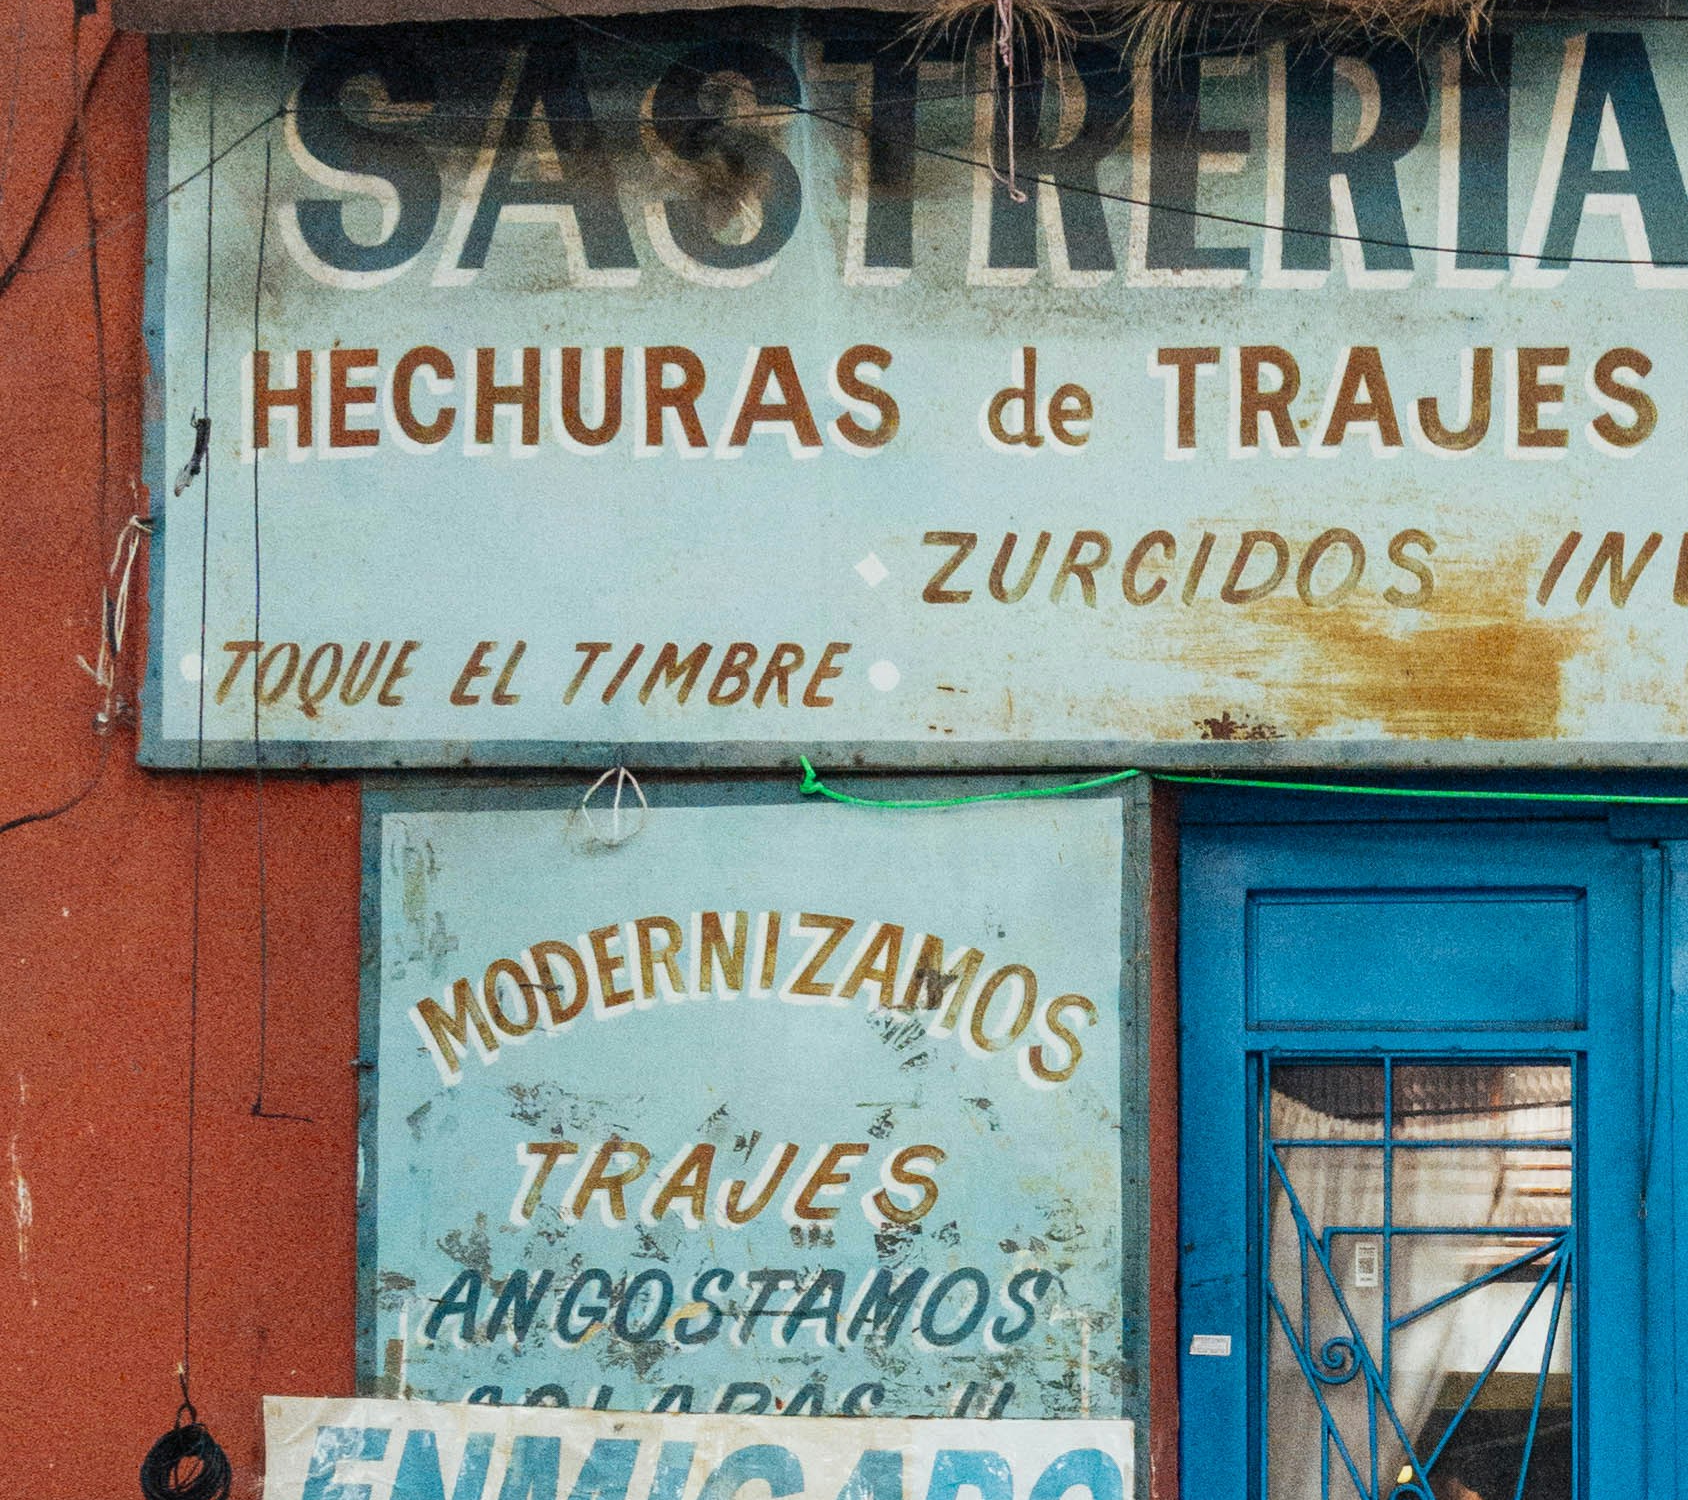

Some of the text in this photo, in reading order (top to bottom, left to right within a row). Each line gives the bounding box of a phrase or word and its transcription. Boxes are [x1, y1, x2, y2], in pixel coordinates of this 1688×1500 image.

[250, 342, 901, 451] HECHURAS
[990, 345, 1094, 450] de
[1155, 344, 1659, 452] TRAJES
[921, 528, 1436, 609] ZURCIDOS
[215, 639, 853, 709] TOQUE EL TIMBRE
[415, 910, 1101, 1084] MODERNIZAMOS
[521, 1141, 948, 1226] TRAJES
[422, 1265, 1054, 1347] ANGOSTAMOS
